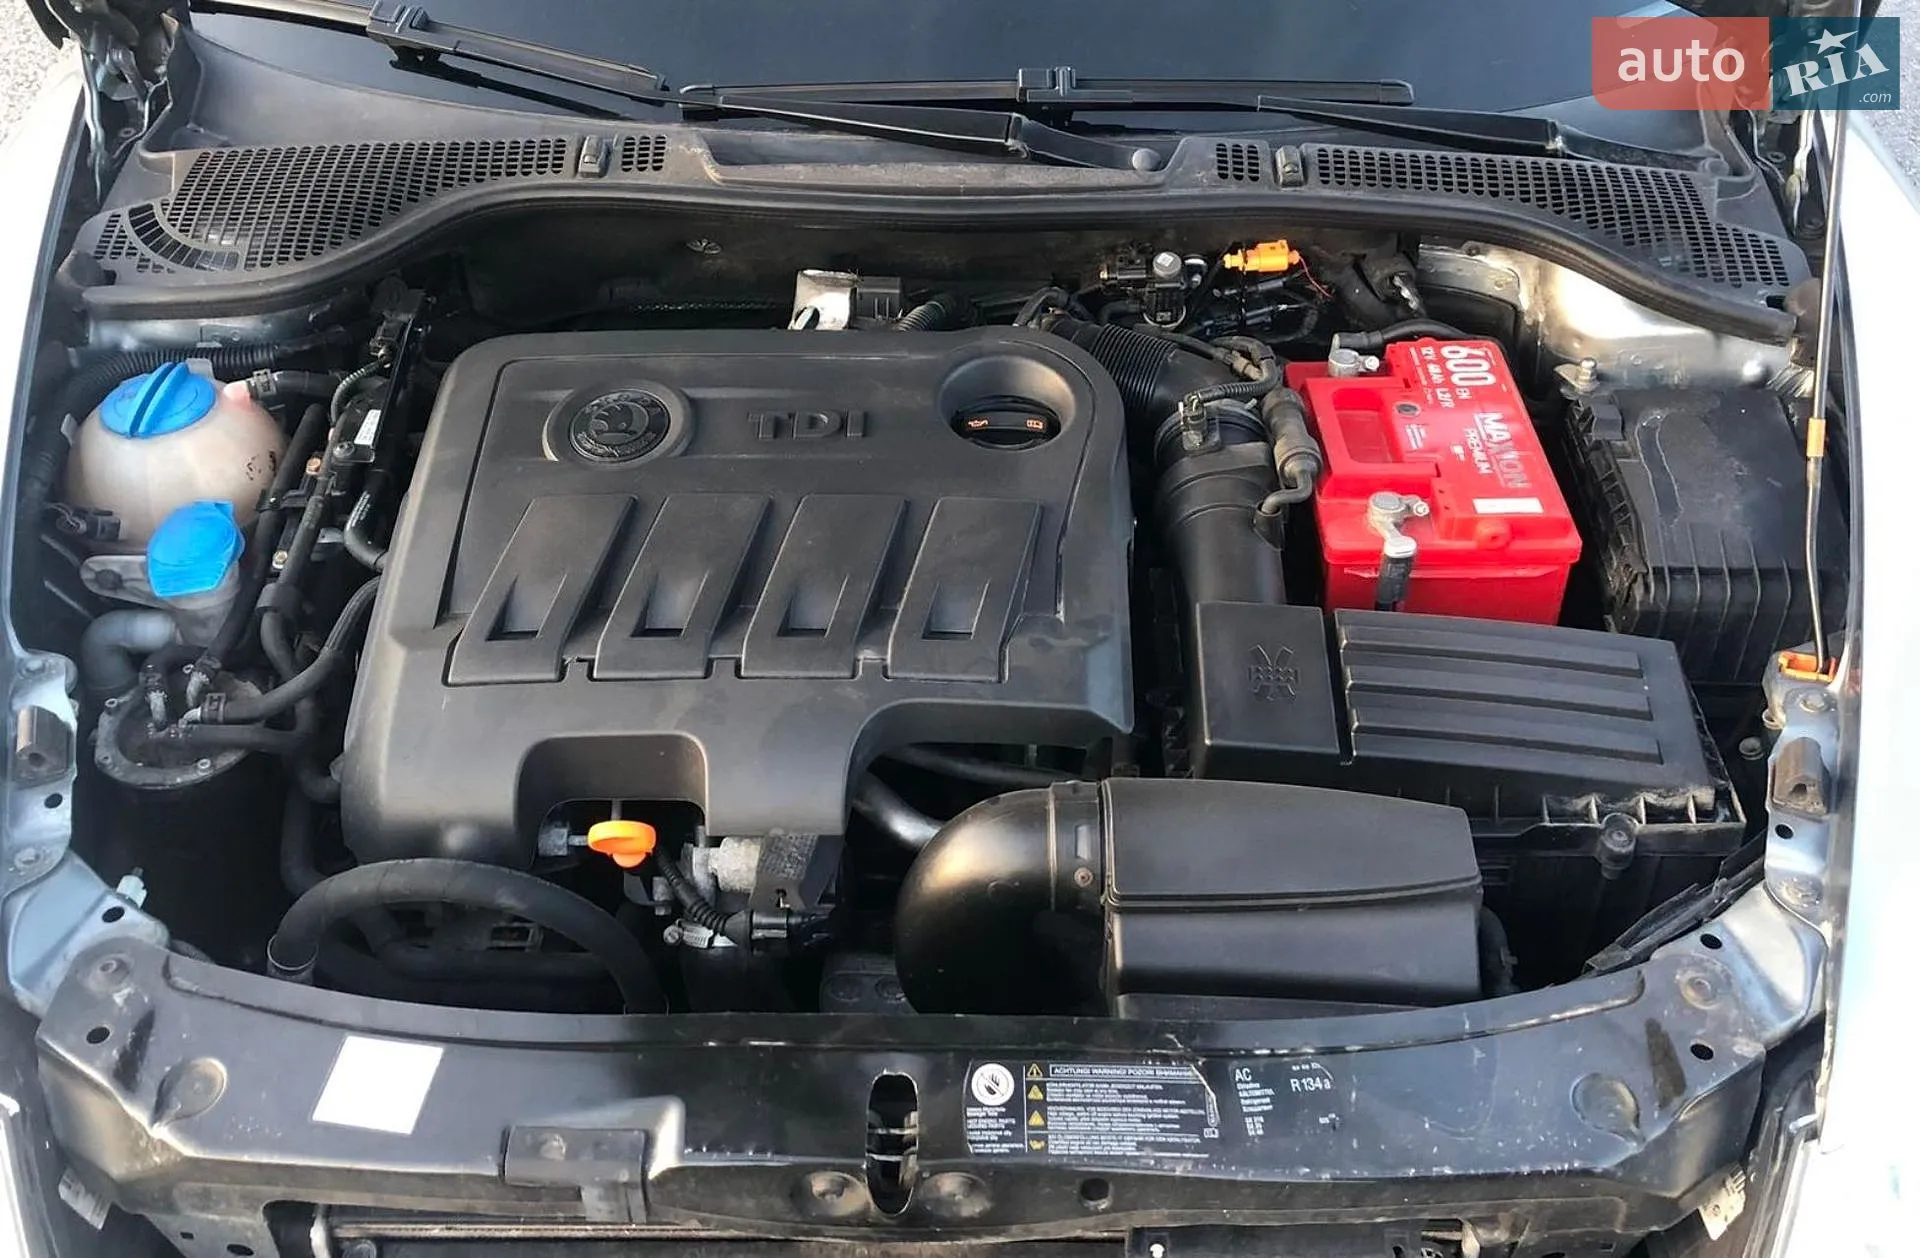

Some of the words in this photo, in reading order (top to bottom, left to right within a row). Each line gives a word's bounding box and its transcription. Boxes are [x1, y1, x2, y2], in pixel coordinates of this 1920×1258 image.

[1440, 345, 1497, 387] 600
[748, 410, 866, 439] TDI
[1235, 1068, 1252, 1081] AC
